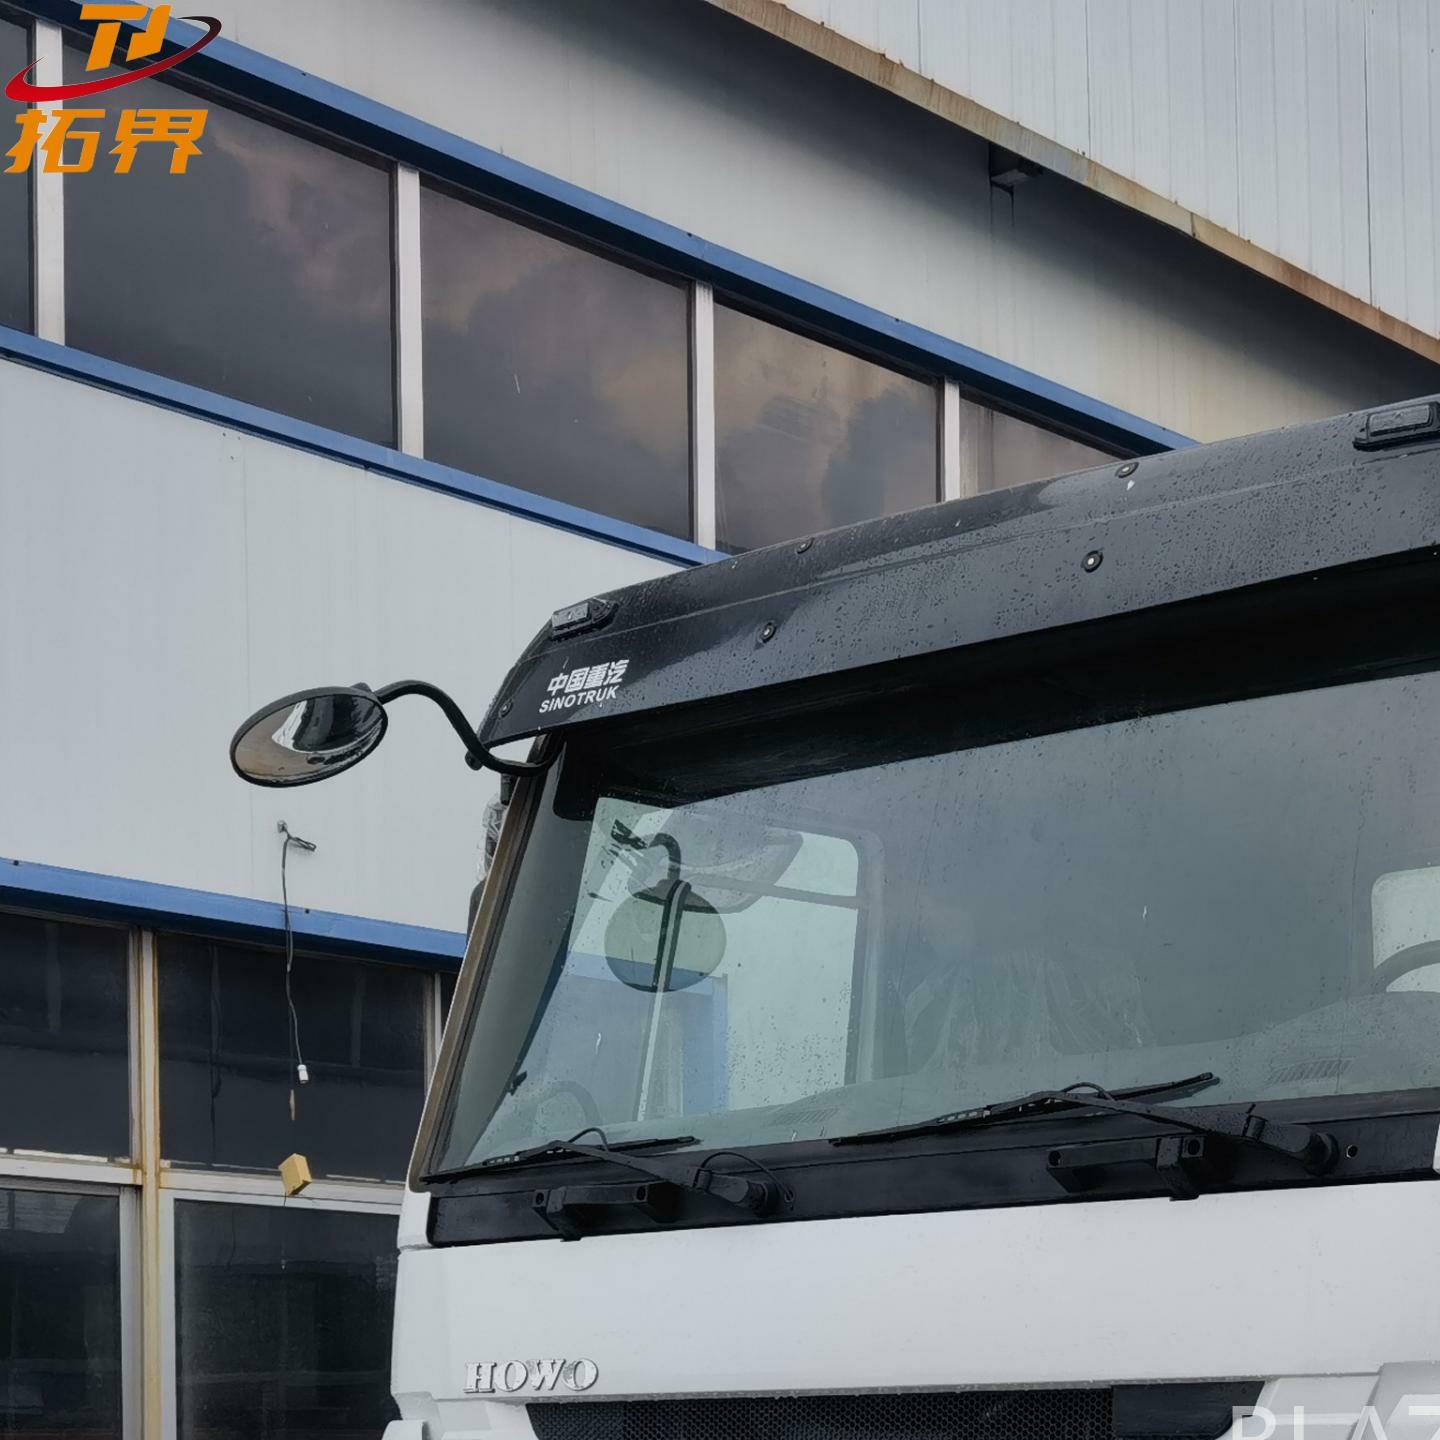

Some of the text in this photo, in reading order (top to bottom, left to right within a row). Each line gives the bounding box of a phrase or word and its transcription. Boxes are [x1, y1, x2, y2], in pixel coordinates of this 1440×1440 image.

[547, 659, 629, 696] 中国重汽
[539, 685, 619, 713] SINOTRUK
[463, 1358, 599, 1393] HOWO
